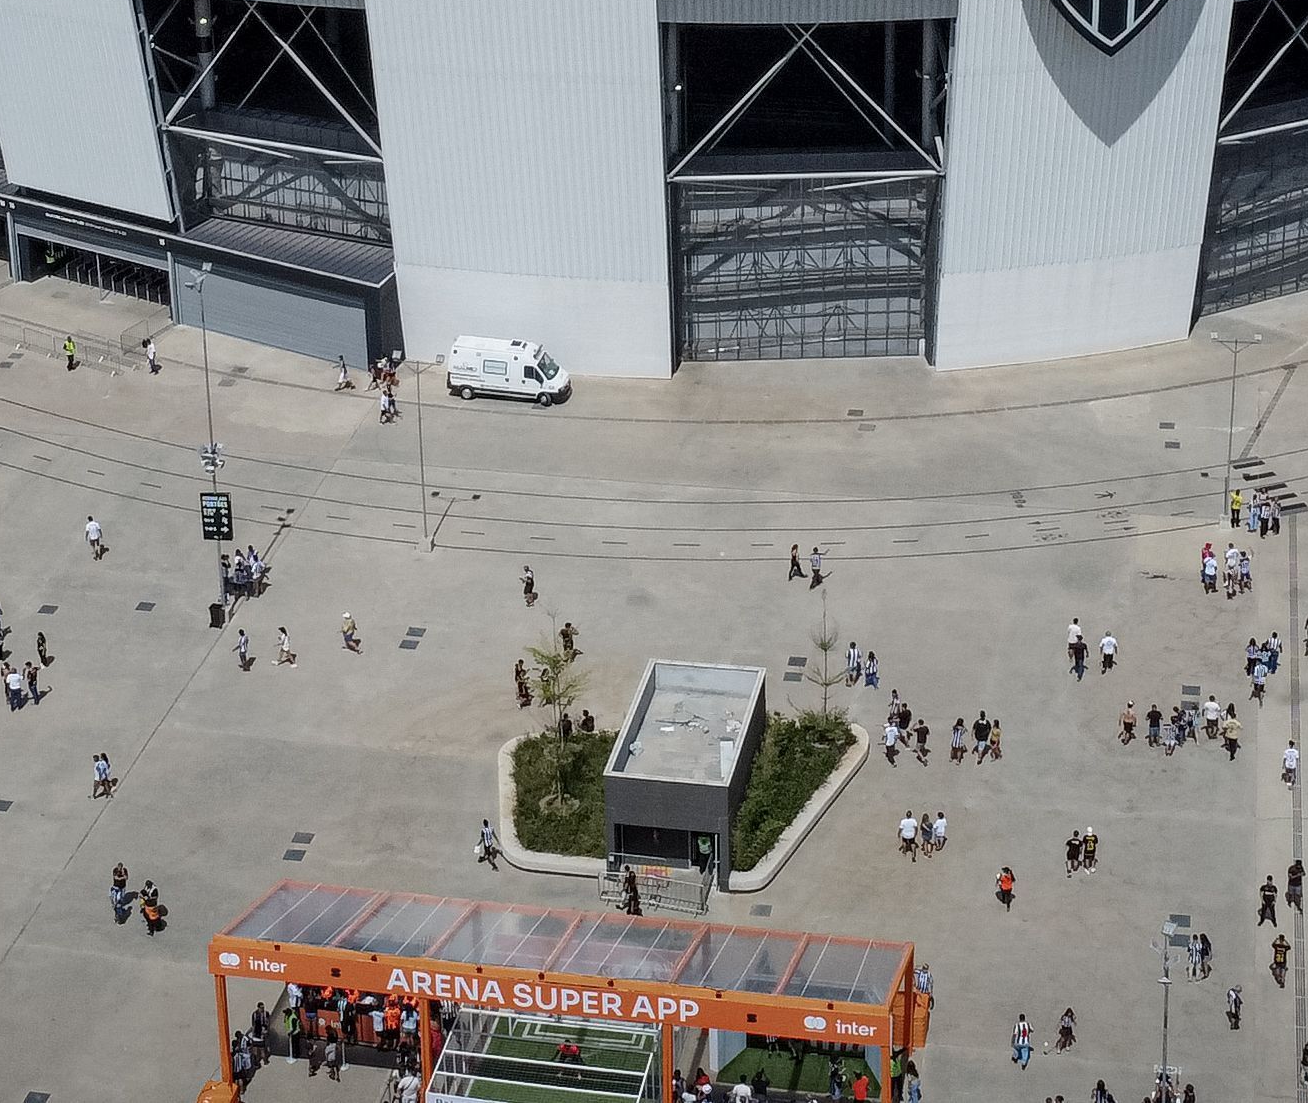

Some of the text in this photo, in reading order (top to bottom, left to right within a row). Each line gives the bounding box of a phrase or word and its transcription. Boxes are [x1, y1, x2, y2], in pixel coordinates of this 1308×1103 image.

[248, 956, 287, 973] inter
[386, 968, 700, 1022] ARENA SUPER APP
[835, 1019, 877, 1037] inter
